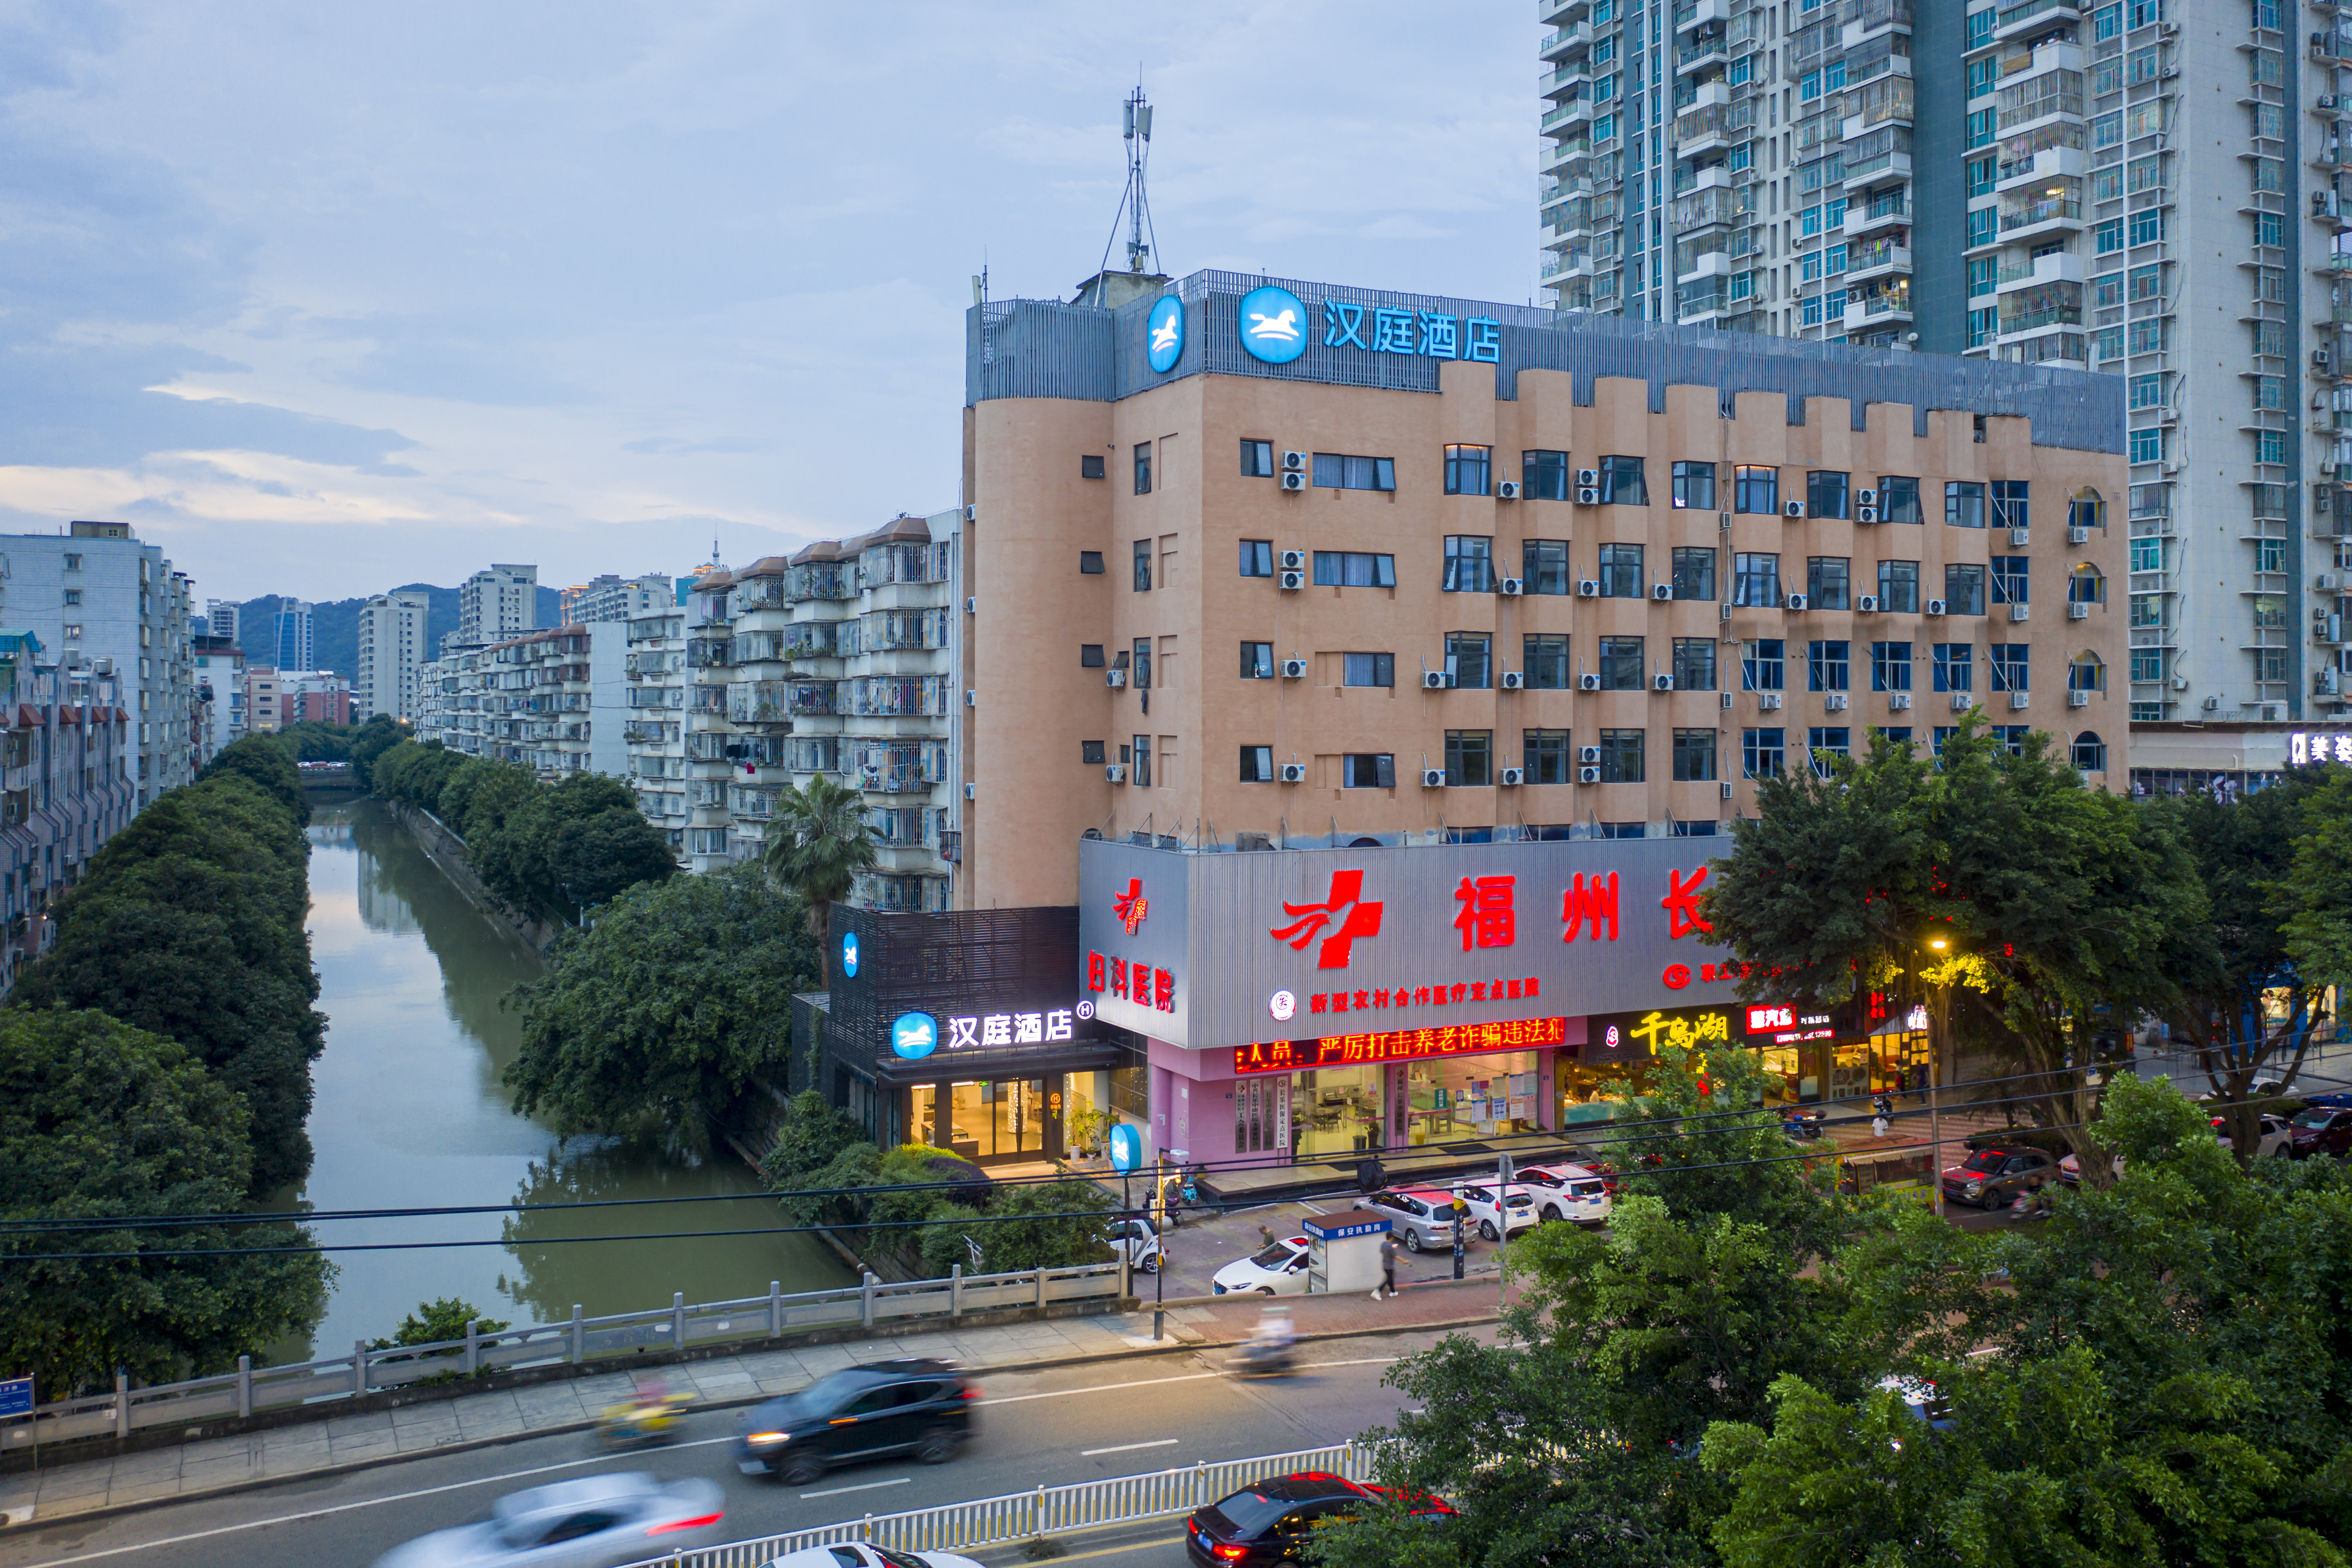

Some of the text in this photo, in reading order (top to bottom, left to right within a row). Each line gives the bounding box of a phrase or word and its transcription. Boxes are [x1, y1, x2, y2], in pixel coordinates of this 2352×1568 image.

[1323, 299, 1500, 363] 汉庭酒店
[1088, 949, 1173, 1014] 妇科医院
[1310, 976, 1540, 1014] 新型农村合作医疗定点医院
[948, 1009, 1073, 1048] 汉庭酒店
[1304, 1221, 1324, 1238] 保安执勤岗
[1338, 1223, 1381, 1237] 保安执勤岗
